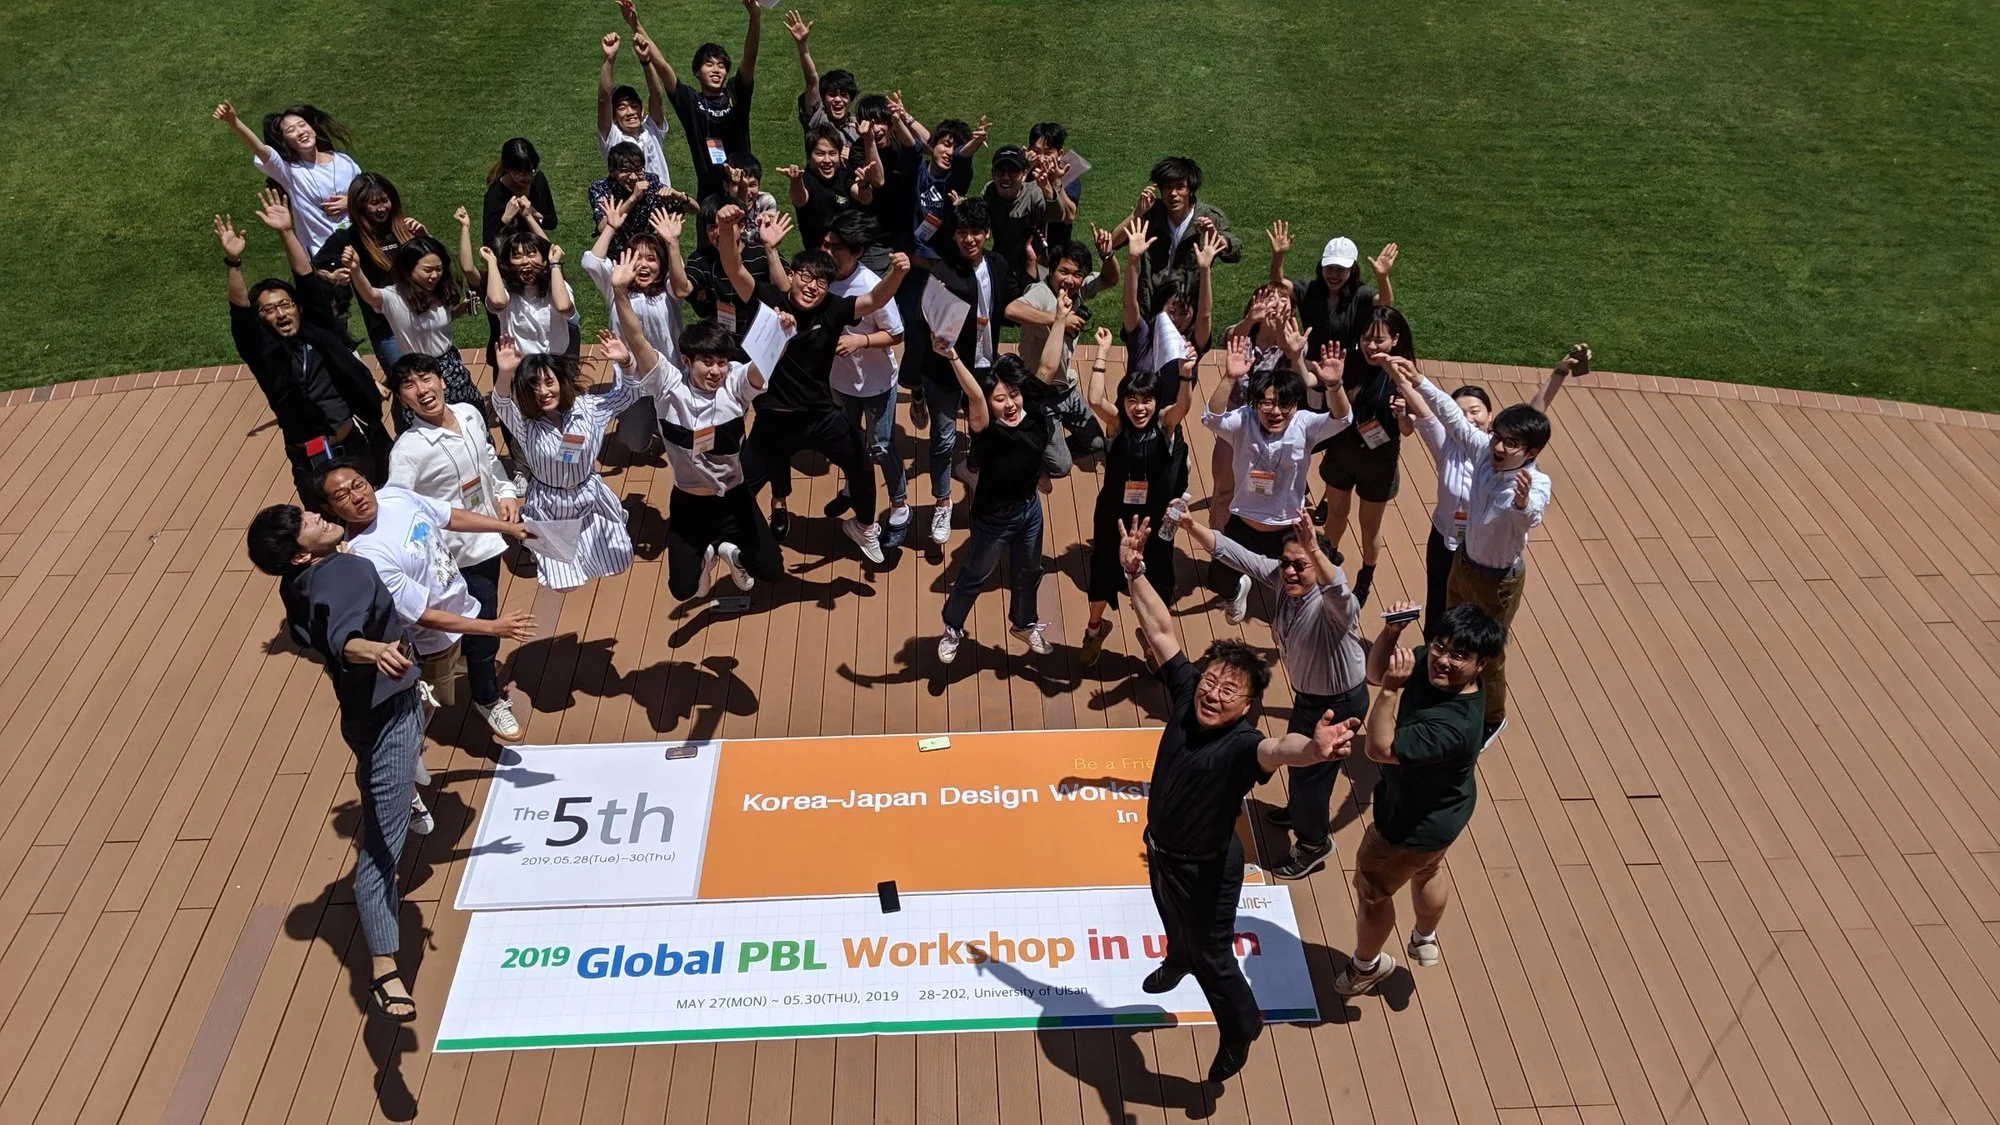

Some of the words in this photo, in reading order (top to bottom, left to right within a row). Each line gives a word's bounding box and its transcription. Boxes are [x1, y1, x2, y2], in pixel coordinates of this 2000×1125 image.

[1074, 757, 1098, 770] Be
[1105, 761, 1116, 770] a
[1122, 757, 1154, 769] Frie
[742, 789, 927, 813] Korea-Japan
[940, 785, 1039, 809] Design
[513, 807, 550, 821] The
[545, 792, 675, 847] 5th
[1116, 809, 1139, 824] In
[500, 946, 570, 968] 2019
[577, 941, 725, 979] Global
[738, 940, 827, 973] PBL
[842, 931, 1075, 969] Workshop
[1088, 929, 1129, 960] in
[676, 999, 706, 1009] MAY
[709, 996, 767, 1009] 27(MON)
[784, 992, 861, 1006] 05.30(THU),
[866, 991, 899, 1002] 2019
[919, 989, 969, 1000] 28-202,
[974, 986, 1034, 998] University
[1039, 986, 1051, 997] of
[1055, 985, 1087, 996] Ulsan
